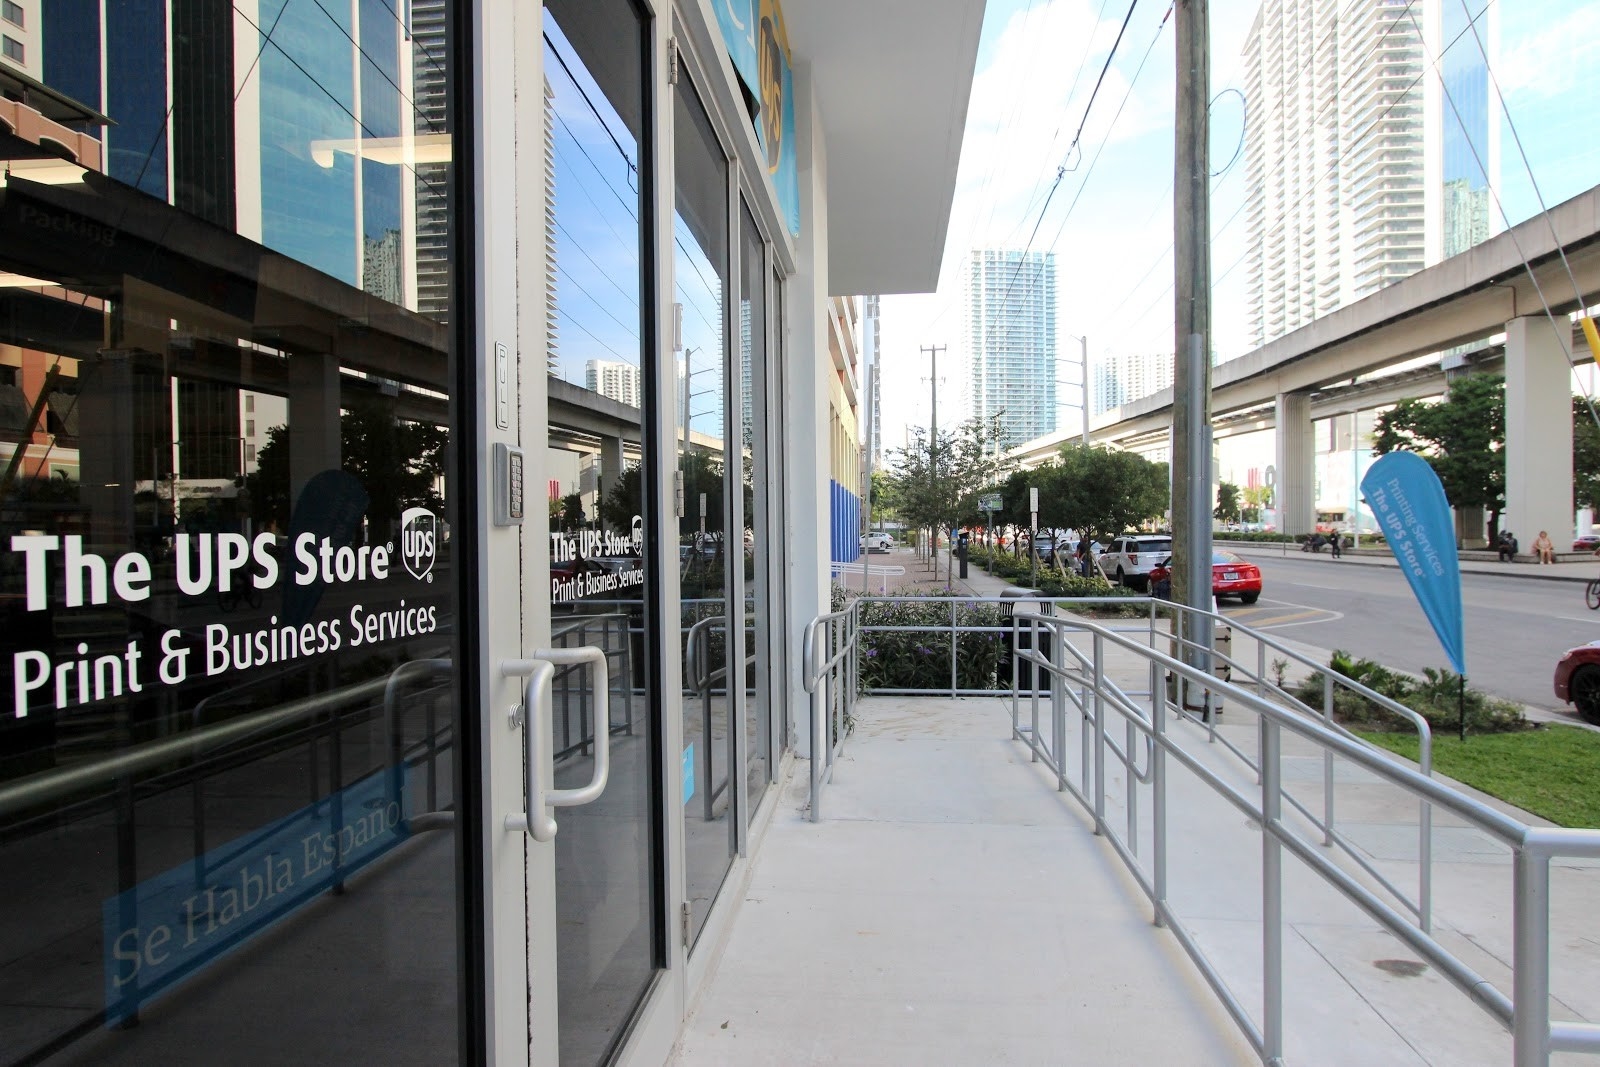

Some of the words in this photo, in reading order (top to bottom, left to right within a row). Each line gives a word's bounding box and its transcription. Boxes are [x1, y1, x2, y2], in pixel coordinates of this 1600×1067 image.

[552, 532, 577, 563] The
[580, 529, 603, 559] UPS
[1373, 487, 1389, 513] The
[1386, 513, 1407, 540] UPS
[1387, 478, 1417, 527] Printing
[1412, 525, 1445, 577] Services
[11, 535, 152, 612] The
[176, 533, 279, 596] UPS
[552, 577, 575, 605] Print
[577, 572, 584, 598] &
[586, 569, 618, 596] Business
[618, 565, 644, 588] Services
[14, 640, 143, 719] Print
[159, 629, 191, 685] &
[206, 616, 341, 677] Business
[350, 599, 437, 647] Services
[113, 923, 172, 988] Se
[182, 854, 294, 949] Habla
